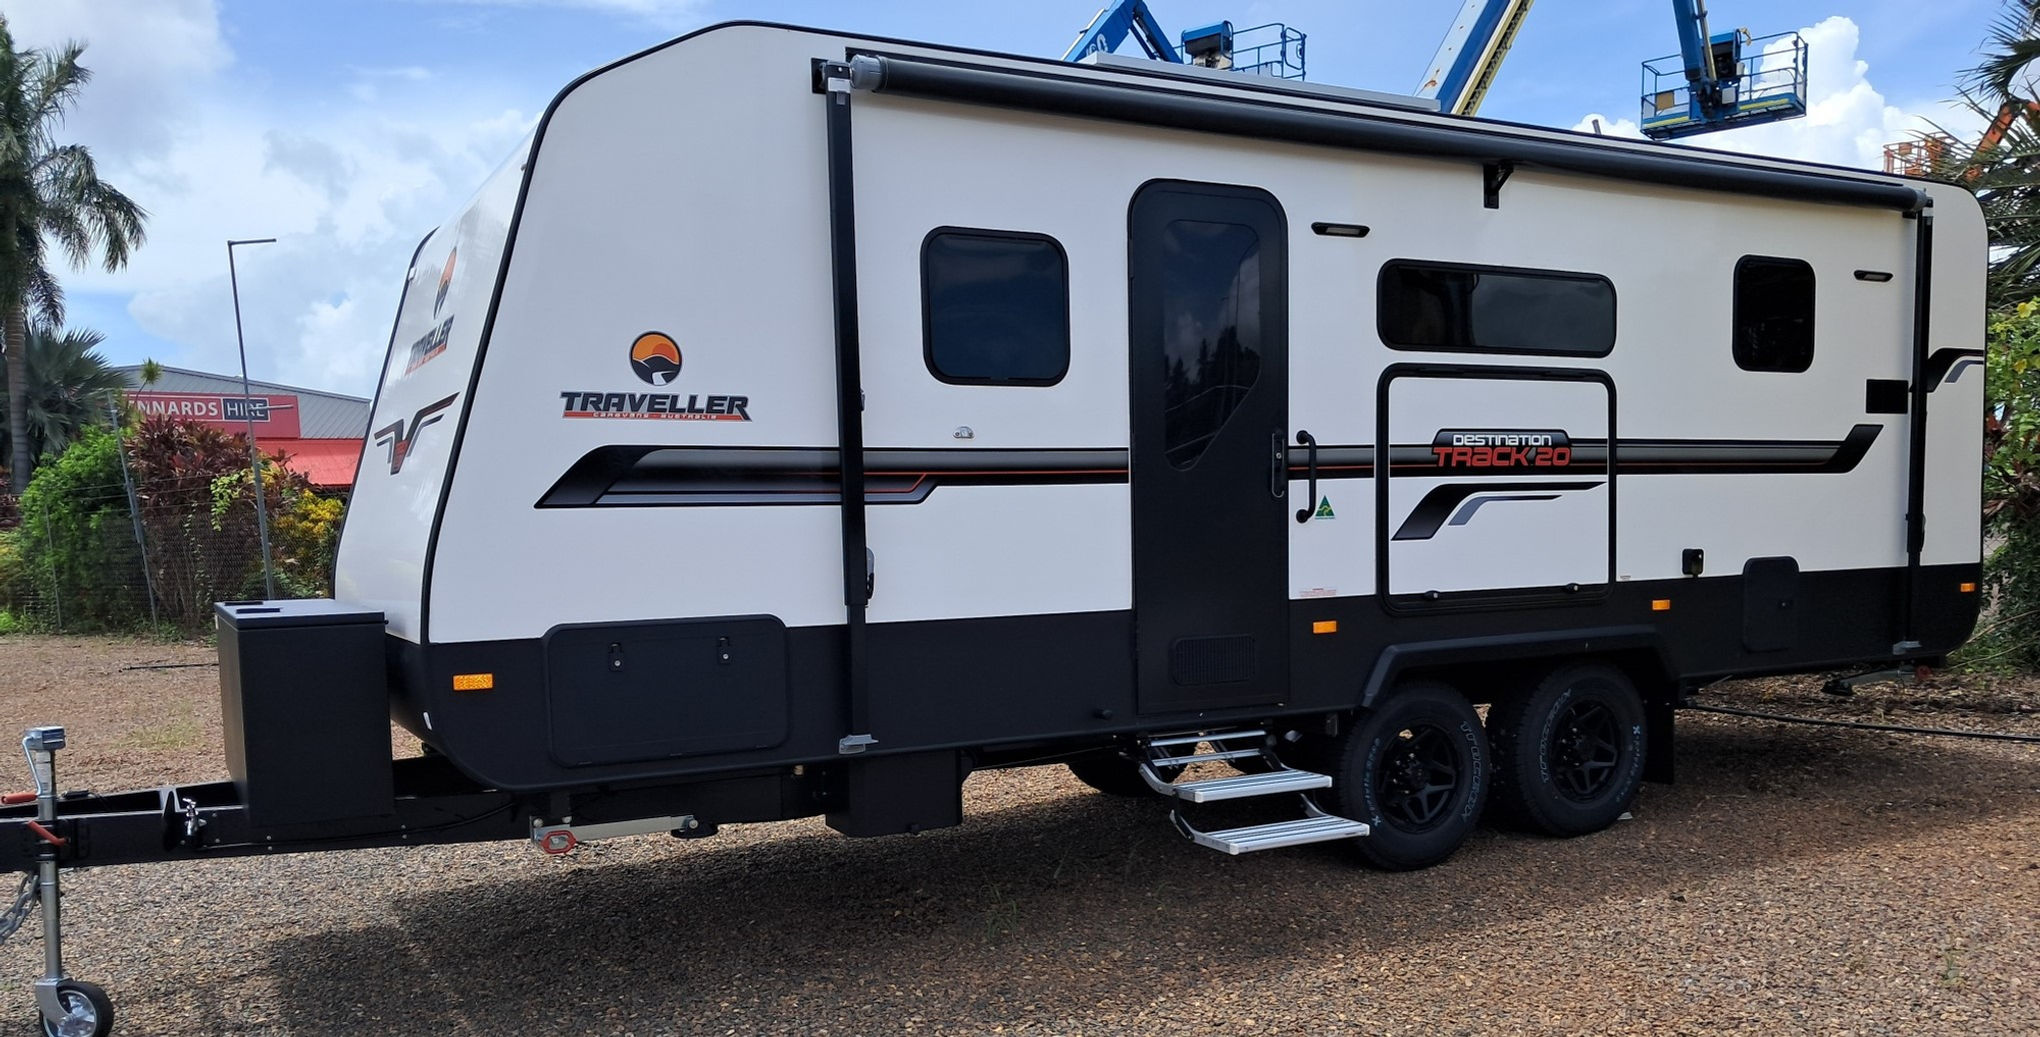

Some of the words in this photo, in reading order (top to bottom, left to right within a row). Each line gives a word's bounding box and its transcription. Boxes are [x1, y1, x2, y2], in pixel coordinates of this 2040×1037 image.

[128, 400, 219, 416] NNARDS
[226, 402, 265, 417] HIRE
[560, 391, 752, 421] TRAVELLER
[1452, 434, 1553, 446] DESTINATION
[1432, 446, 1531, 467] TRACK
[1534, 446, 1571, 467] 20
